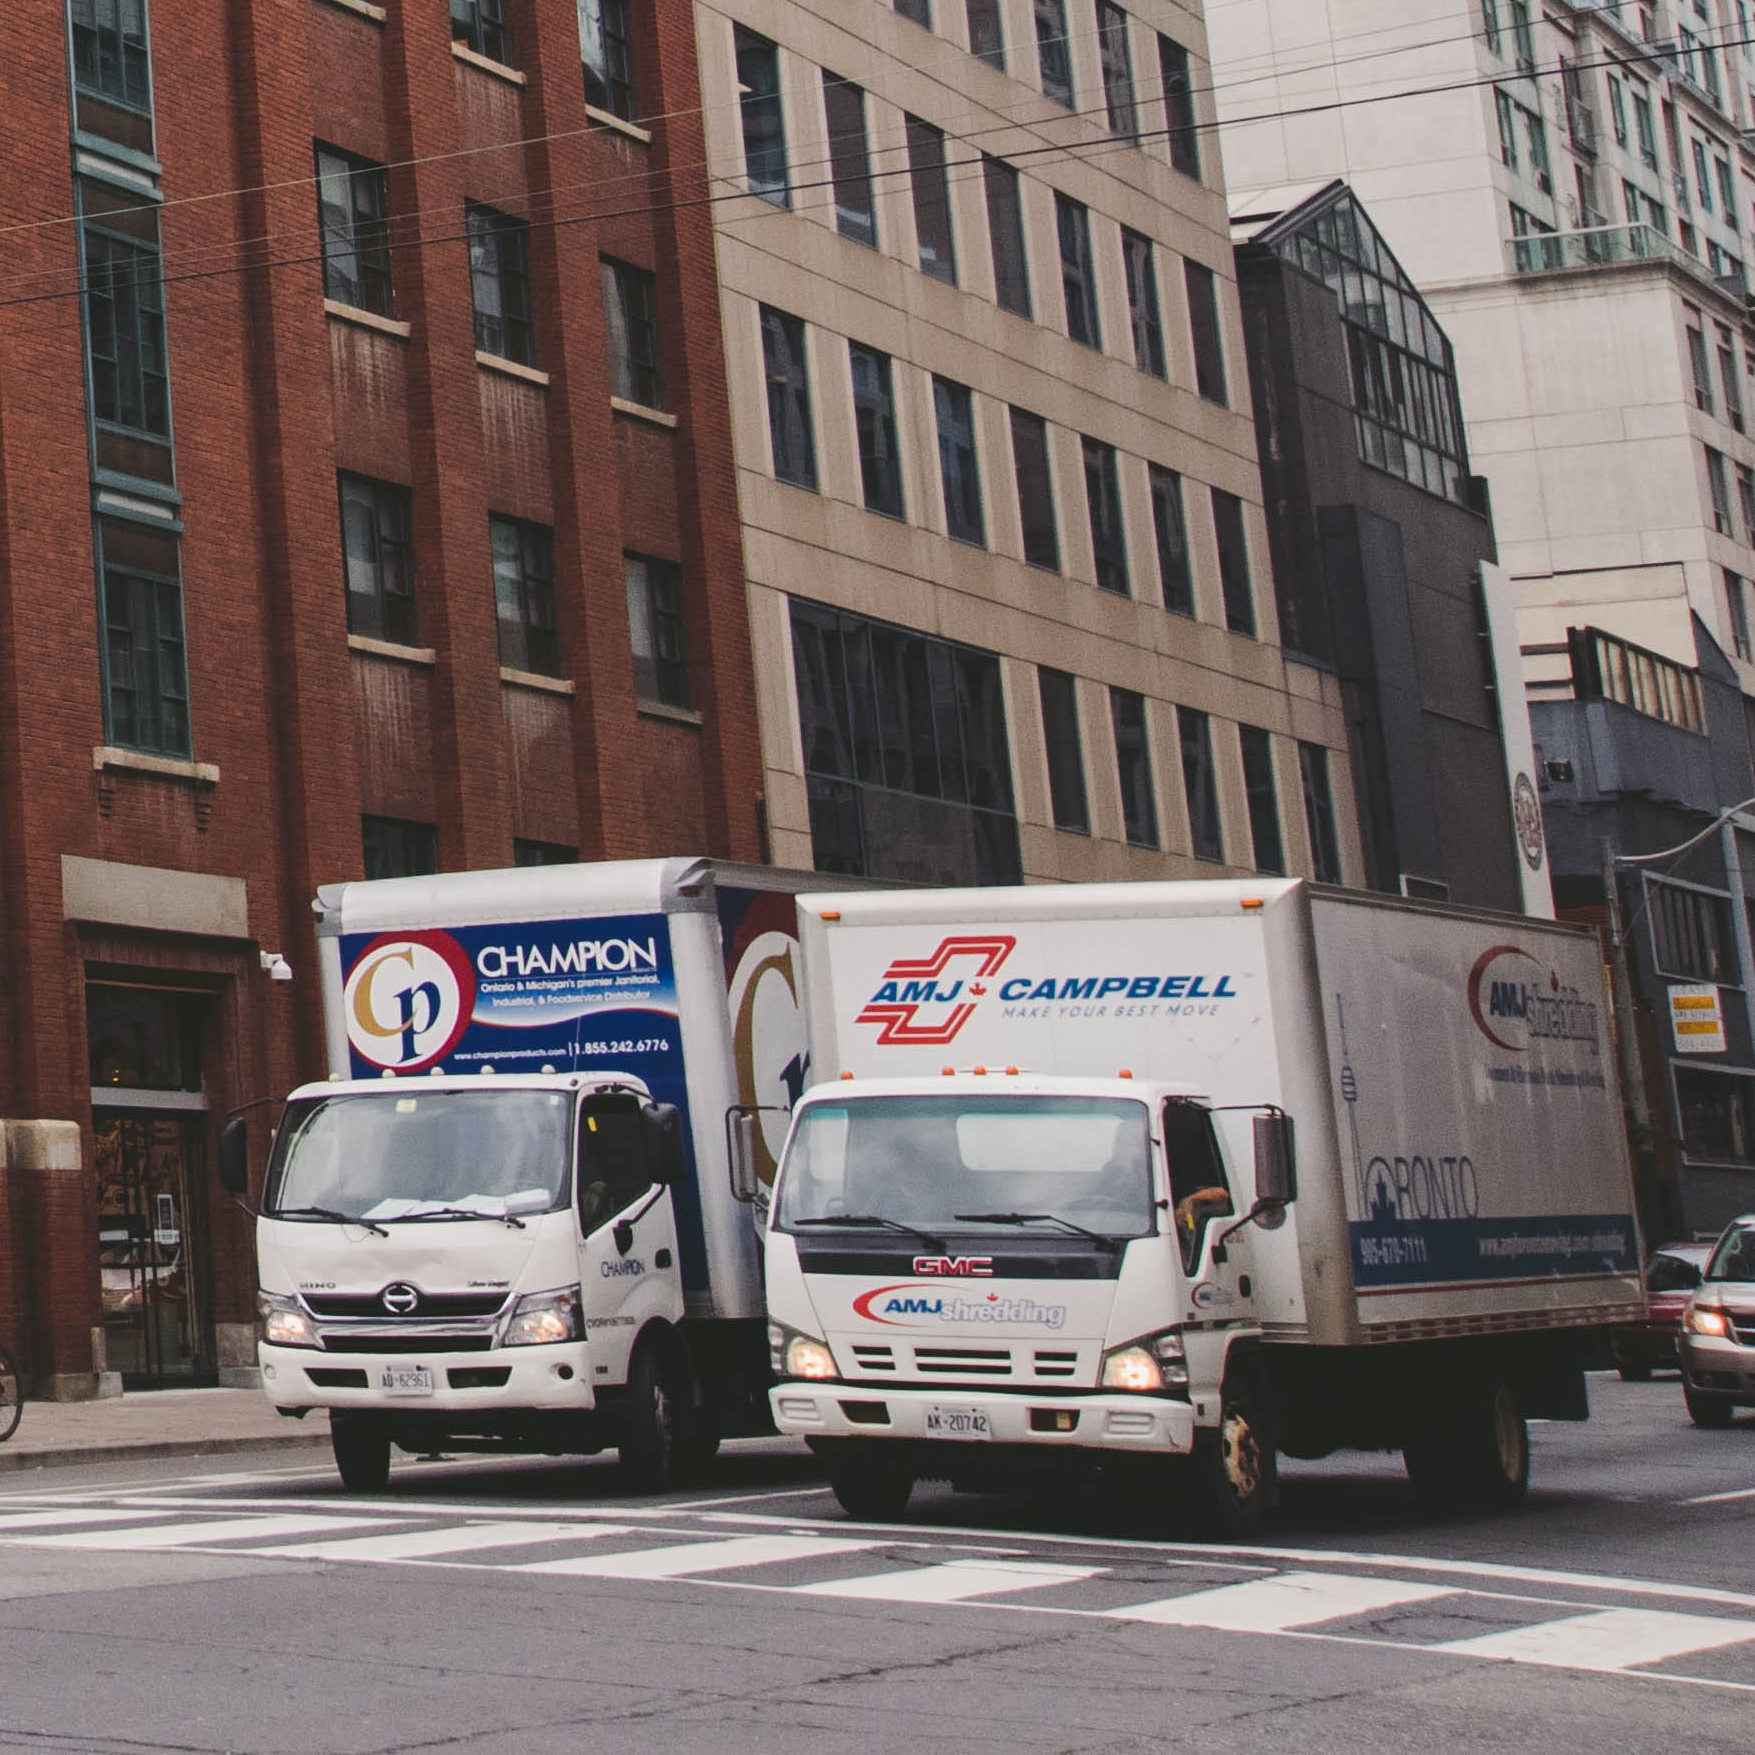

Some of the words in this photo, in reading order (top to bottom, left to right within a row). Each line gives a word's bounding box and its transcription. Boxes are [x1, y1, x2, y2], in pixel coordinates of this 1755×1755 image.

[477, 937, 657, 978] CHAMPION
[481, 982, 515, 993] Ontario
[526, 979, 575, 991] Michigan's
[577, 977, 613, 989] premier
[870, 980, 964, 1002] AMJ
[999, 975, 1237, 1001] CAMPBELL
[547, 993, 602, 1004] Foodservice
[604, 990, 650, 1002] Distributor
[1002, 1006, 1051, 1019] MAKE
[1058, 1006, 1106, 1018] YOUR
[1115, 1005, 1160, 1017] BEST
[1168, 1004, 1220, 1017] MOVE
[454, 1049, 567, 1060] www.championproducts.com
[601, 1259, 646, 1277] CHAMPION
[913, 1256, 993, 1276] GMC
